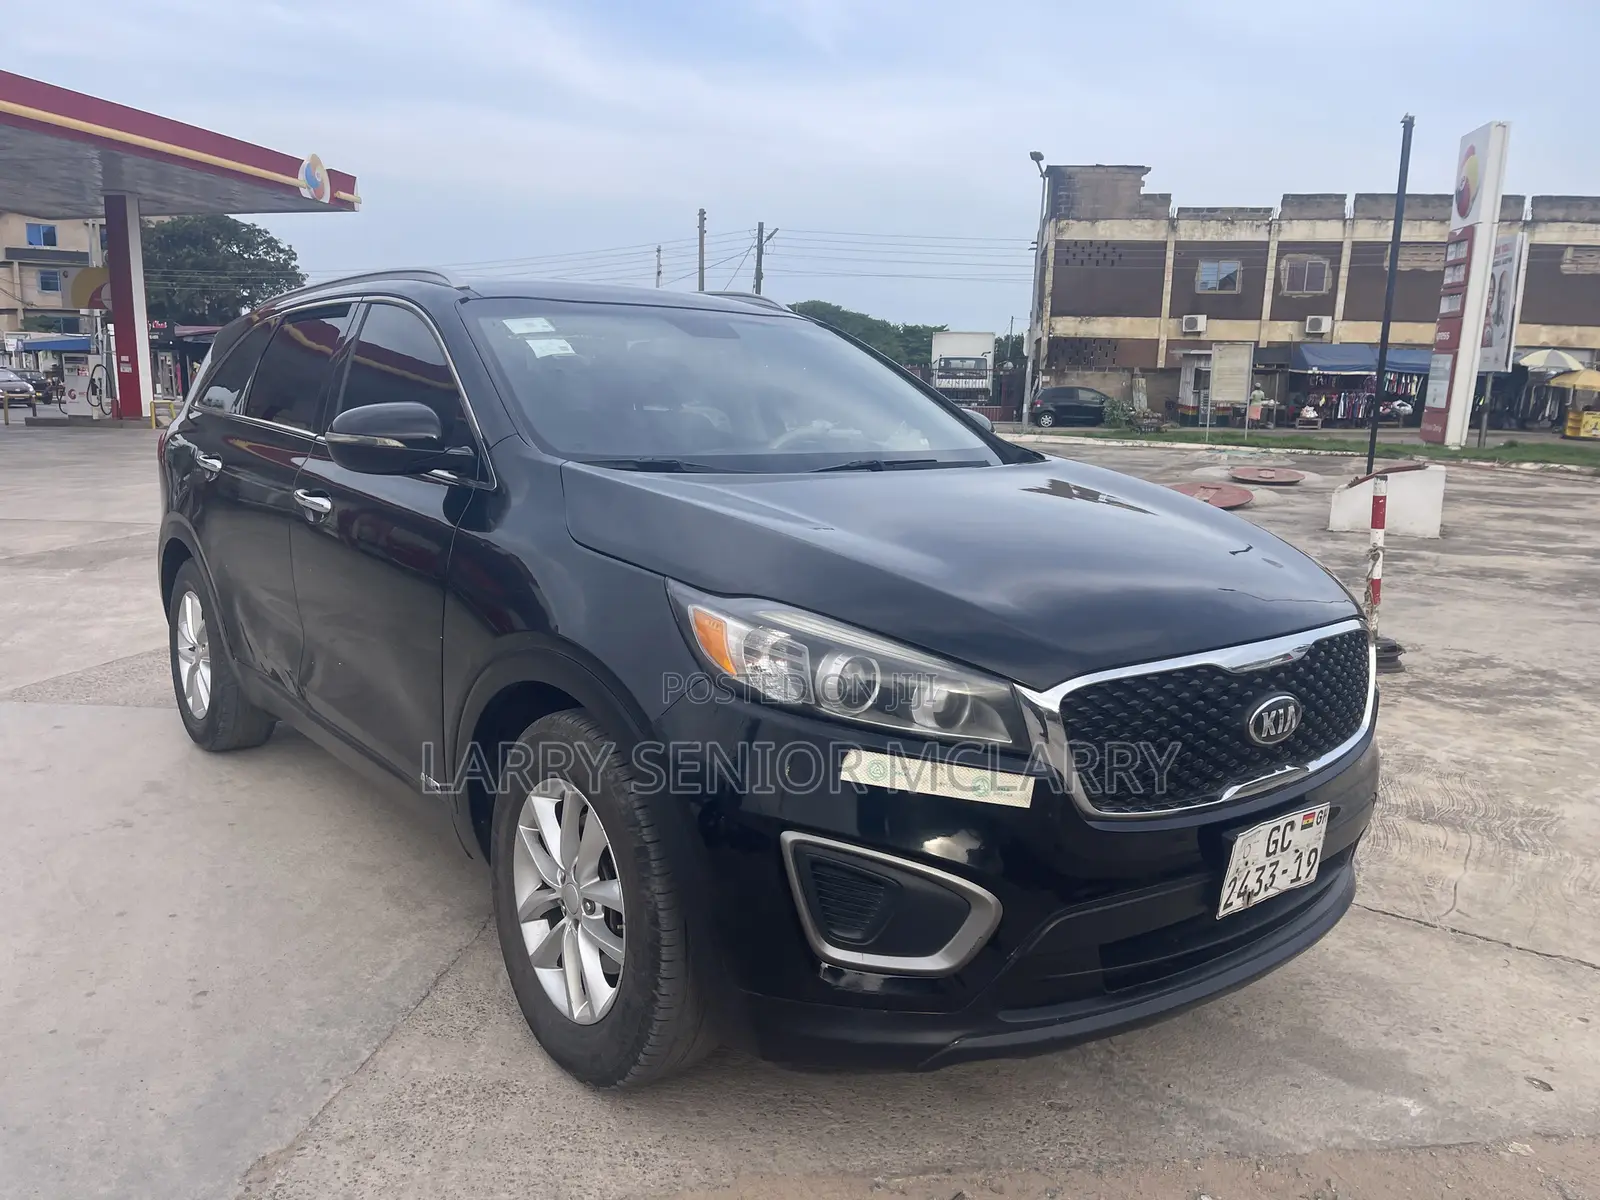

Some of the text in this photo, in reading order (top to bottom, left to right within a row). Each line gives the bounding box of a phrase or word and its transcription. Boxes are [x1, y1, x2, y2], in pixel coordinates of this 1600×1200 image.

[1261, 705, 1296, 738] KIA
[1265, 820, 1295, 858] GC
[1223, 847, 1319, 911] 2433-19
